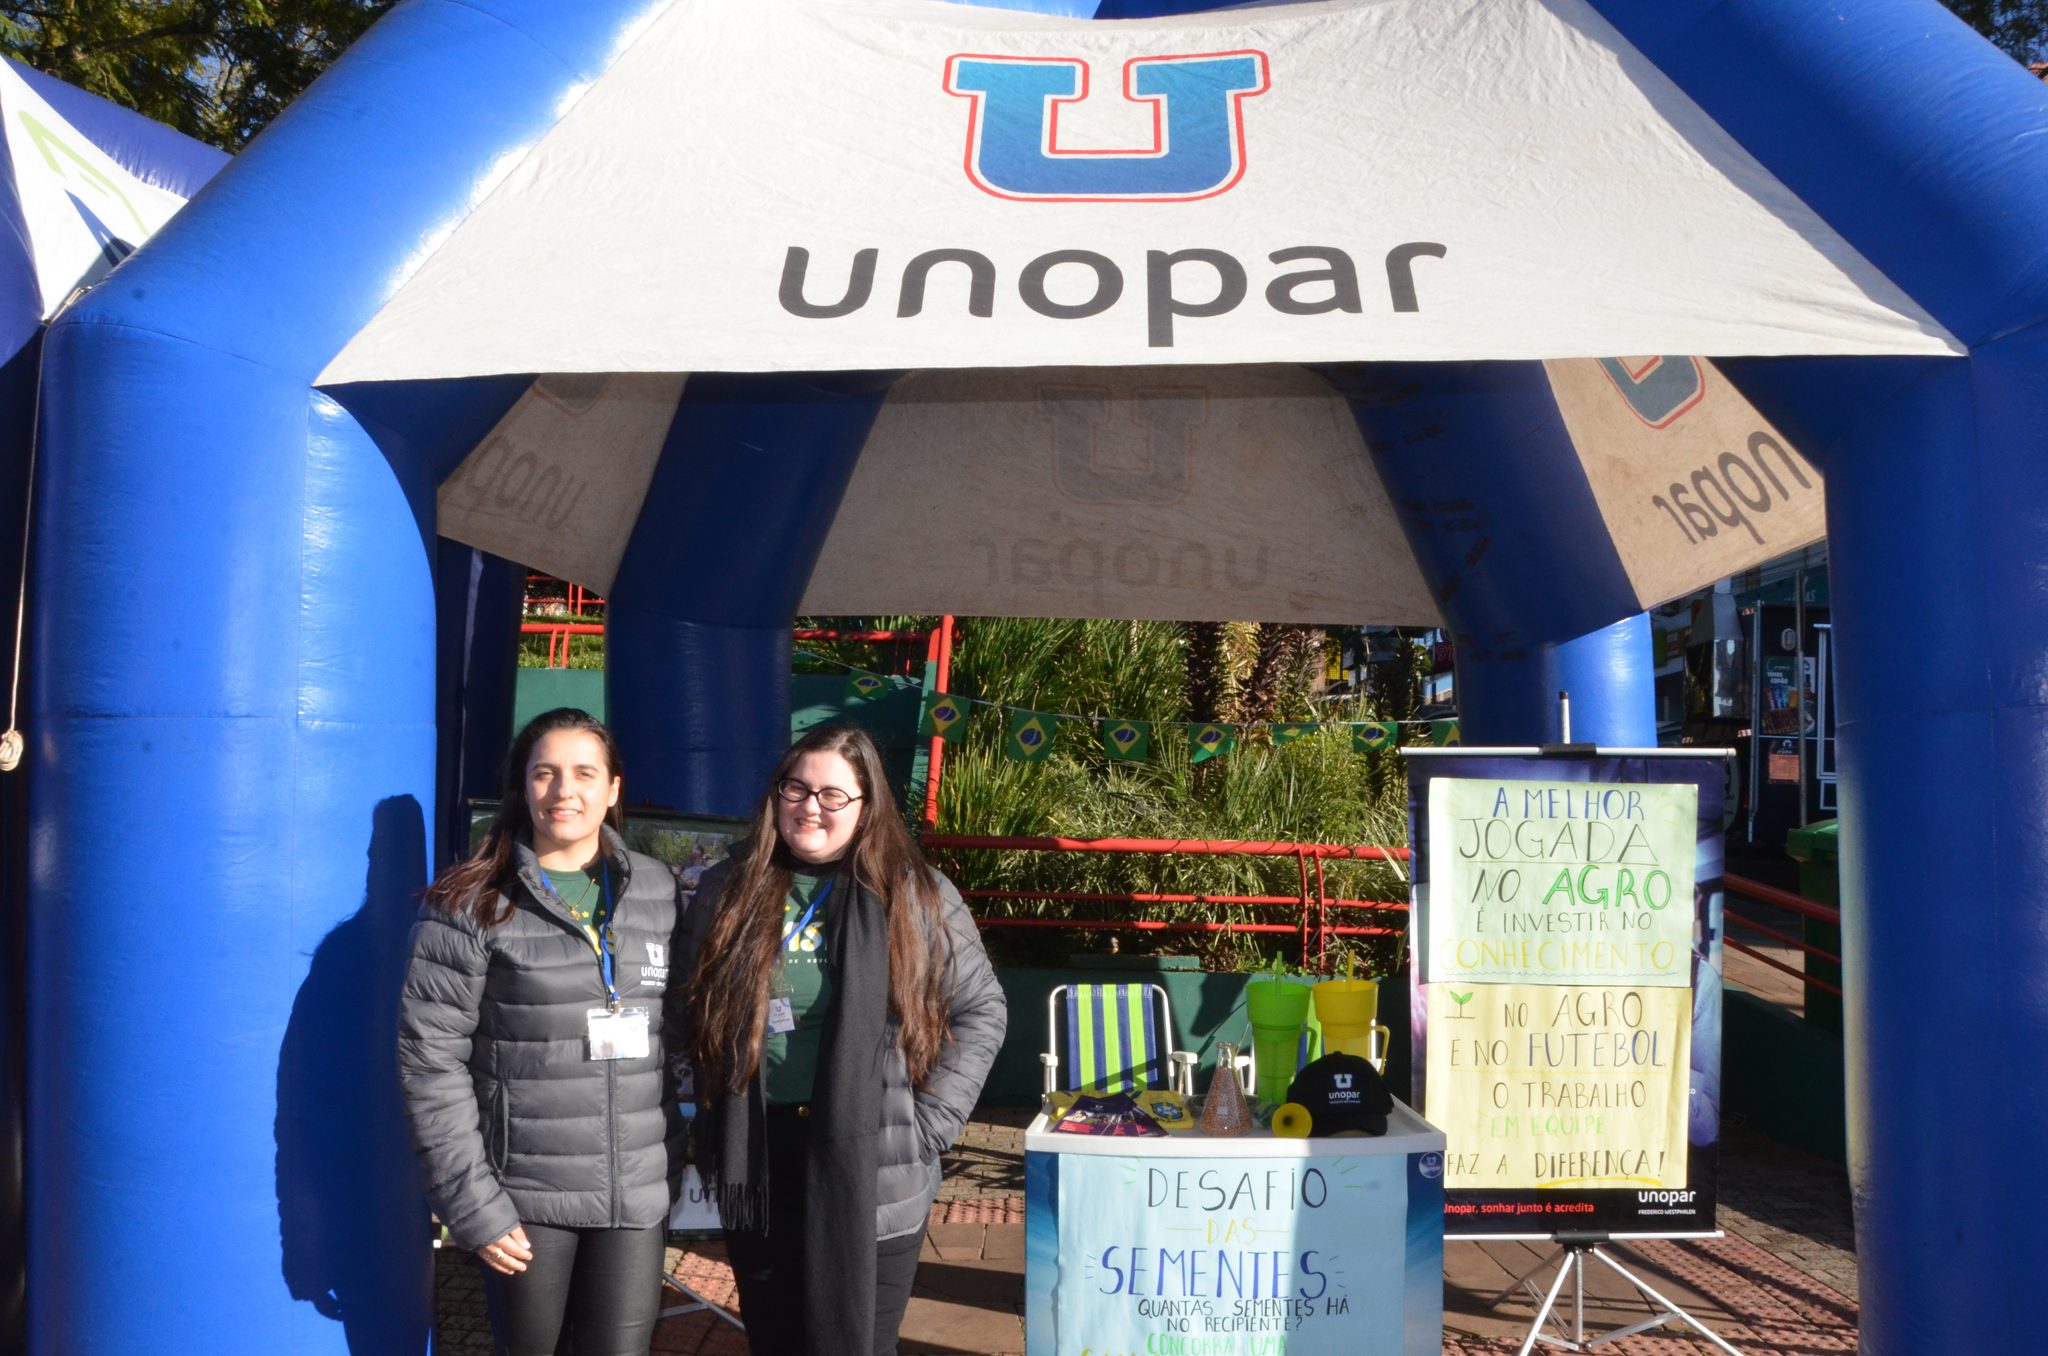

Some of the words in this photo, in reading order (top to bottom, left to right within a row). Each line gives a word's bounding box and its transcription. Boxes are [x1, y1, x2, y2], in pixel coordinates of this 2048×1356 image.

[779, 241, 1447, 347] unopar
[1492, 786, 1511, 819] A
[1524, 788, 1645, 821] MELHOR
[1459, 817, 1659, 862] JOGADA
[1472, 868, 1521, 904] NO
[1542, 864, 1672, 911] AGRO
[1502, 908, 1610, 935] INVESTIR
[1622, 911, 1653, 931] NO
[1440, 938, 1675, 972] CONHECIMENTO
[1504, 1002, 1529, 1029] NO
[1551, 991, 1644, 1029] AGRO
[1474, 1039, 1509, 1067] NO
[1328, 1091, 1361, 1101] unopar
[1492, 1081, 1509, 1109] O
[1522, 1080, 1647, 1110] TRABALHO
[1490, 1117, 1520, 1138] EM
[1531, 1114, 1606, 1137] EQUIPE
[1447, 1153, 1480, 1176] FAZ
[1496, 1154, 1508, 1175] A
[1481, 1202, 1515, 1214] sonhar
[1516, 1201, 1544, 1216] junto
[1545, 1201, 1552, 1213] é
[1554, 1201, 1595, 1213] acredita
[1638, 1191, 1697, 1207] unopar
[1206, 1217, 1257, 1245] DAS
[1099, 1245, 1328, 1300] SEMENTES
[1138, 1299, 1214, 1319] QUANTAS
[1232, 1298, 1315, 1318] SEMENTES
[1326, 1294, 1350, 1315] HÁ
[1167, 1317, 1191, 1333] NO
[1205, 1315, 1304, 1333] RECIPIENTE?
[1147, 1333, 1235, 1356] CONCORRA
[1250, 1334, 1288, 1356] UMA
